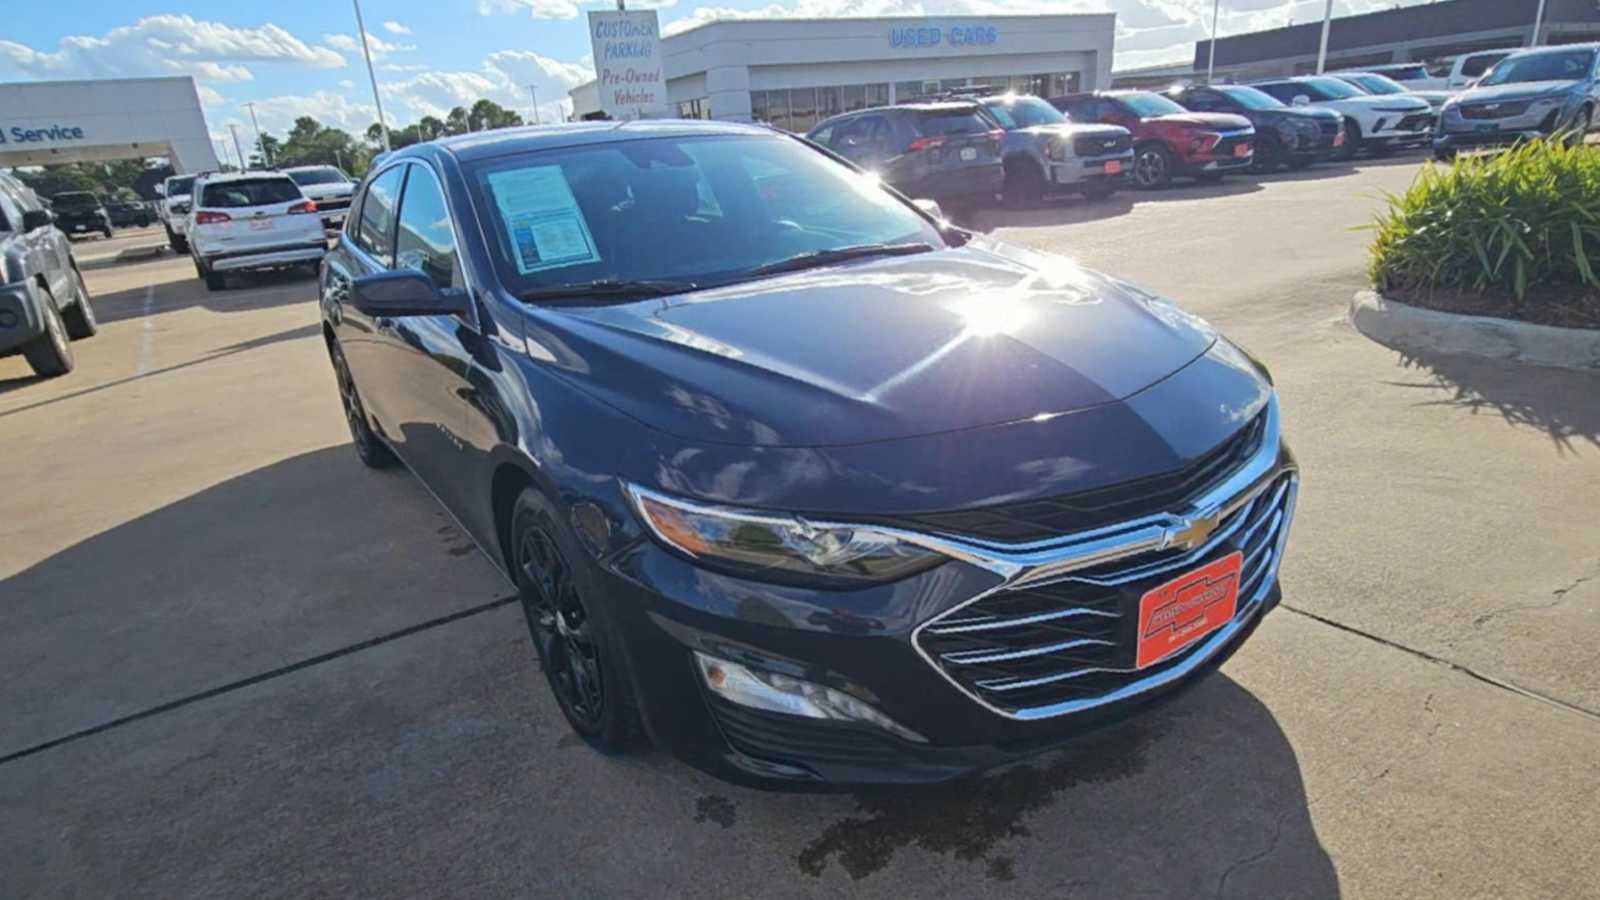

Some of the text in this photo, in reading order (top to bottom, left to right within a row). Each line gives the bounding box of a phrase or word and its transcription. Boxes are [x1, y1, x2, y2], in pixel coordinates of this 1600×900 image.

[888, 25, 998, 47] USED CARS
[602, 67, 660, 84] Pre-Owned
[614, 88, 655, 105] Vehicles
[10, 125, 84, 142] Service
